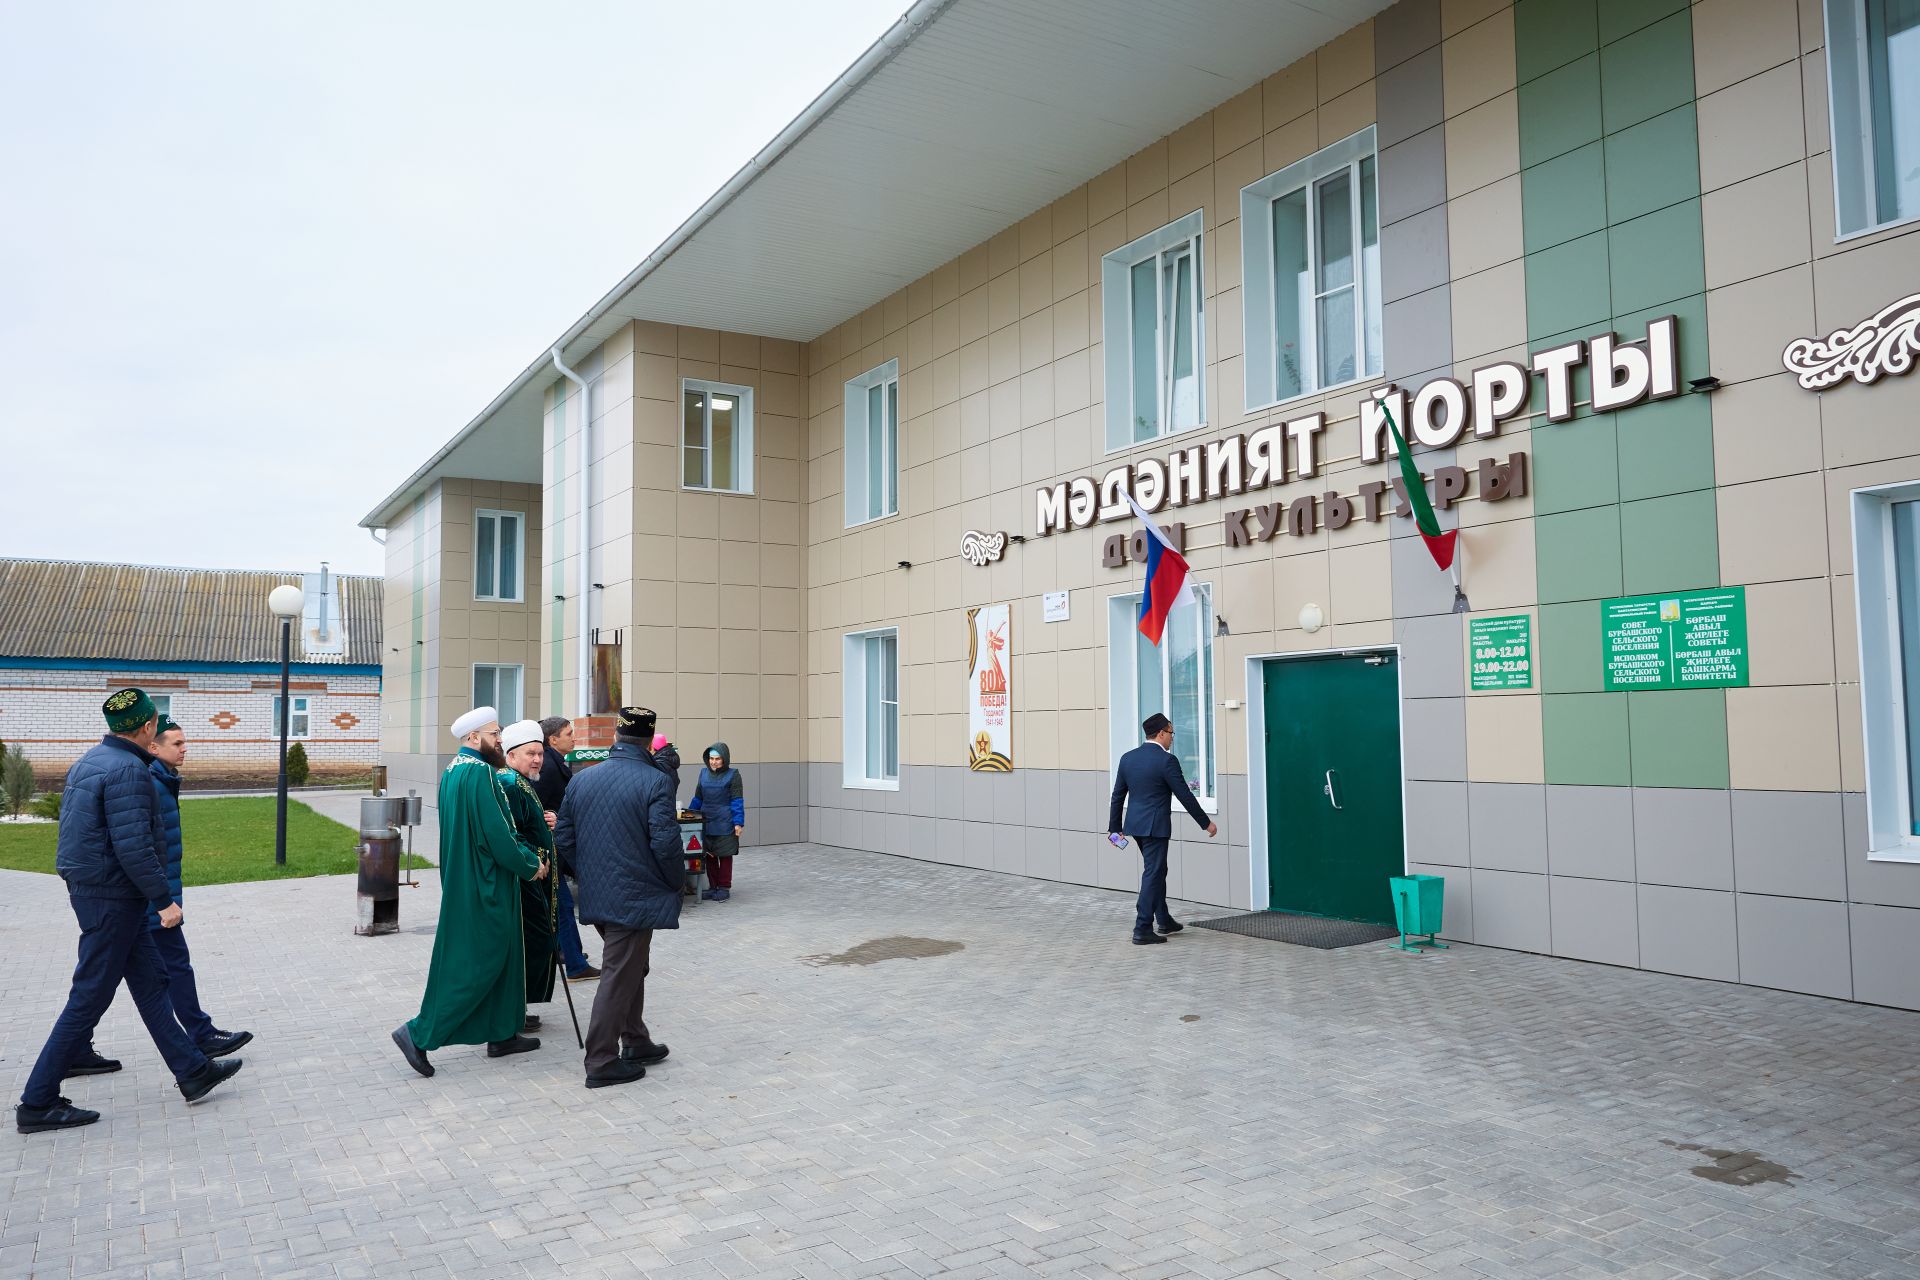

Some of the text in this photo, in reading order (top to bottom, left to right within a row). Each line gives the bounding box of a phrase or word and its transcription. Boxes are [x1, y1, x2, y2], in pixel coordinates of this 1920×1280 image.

[1036, 314, 1677, 536] МӘДӘНИЯТ ЙОРТЫ
[1685, 614, 1726, 624] БӨРБАШ
[1622, 621, 1647, 629] СОВЕТ
[1693, 622, 1720, 631] АВЫЛ
[1608, 627, 1662, 637] БУРБАШСКОГО
[1612, 635, 1658, 644] СЕЛЬСКОГО
[1688, 638, 1727, 647] СОВЕТЫ
[1612, 642, 1659, 651] ПОСЕЛЕНИЯ
[1614, 653, 1658, 662] ИСПОЛКОМ
[1675, 648, 1741, 658] БӨРБАШ АВЫЛ
[1608, 660, 1665, 669] БУРБАШСКОГО
[1681, 664, 1736, 673] БАШКАРМА
[1614, 668, 1659, 676] СЕЛЬСКОГО
[1682, 672, 1736, 680] КОМИТЕТЫ
[1613, 675, 1661, 683] ПОСЕЛЕНИЯ
[980, 694, 1007, 708] ПОБЕДА!
